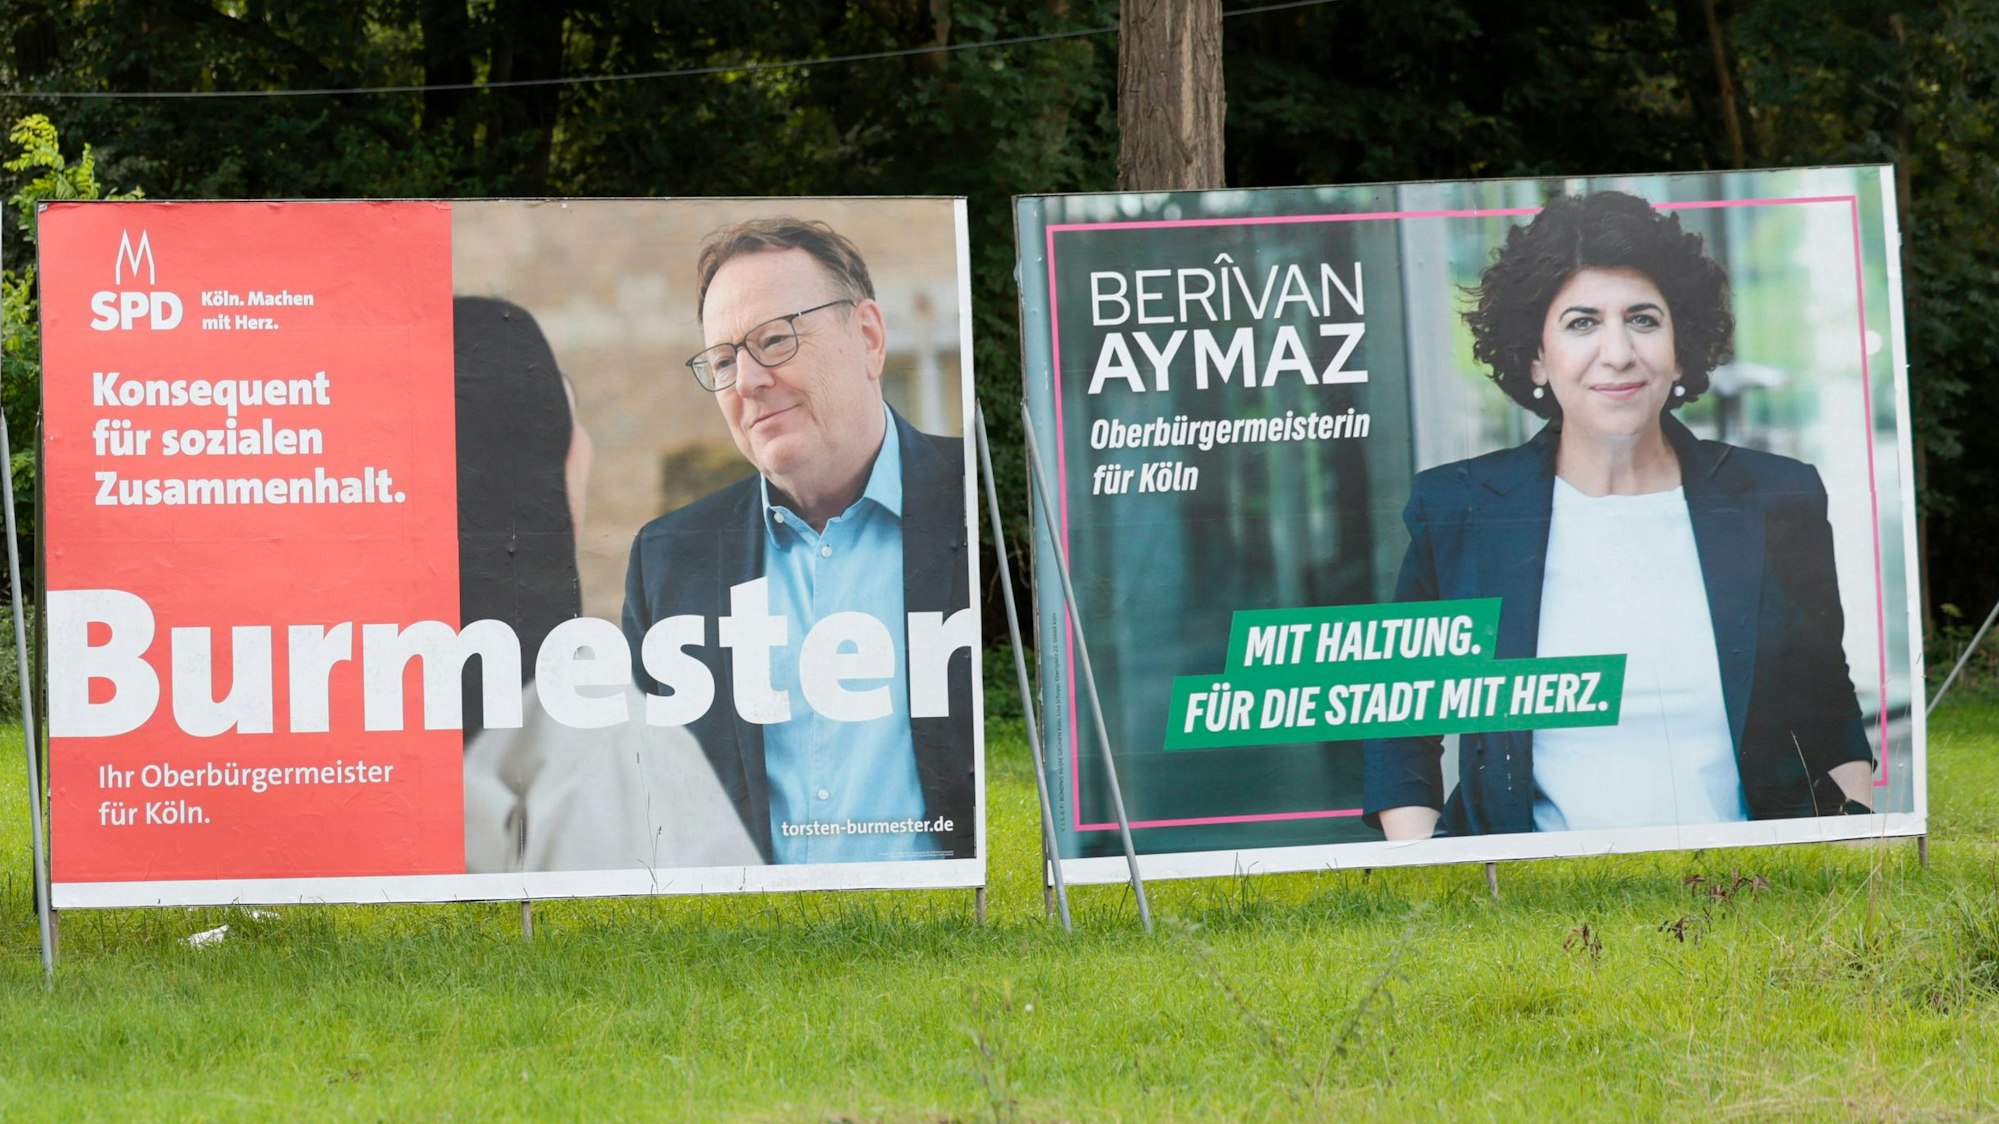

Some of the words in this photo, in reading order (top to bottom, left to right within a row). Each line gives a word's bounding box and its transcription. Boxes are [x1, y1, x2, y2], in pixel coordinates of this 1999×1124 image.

[201, 291, 245, 306] Köln.
[248, 290, 314, 306] Machen
[1090, 253, 1365, 326] BERÎVAN
[90, 291, 184, 331] SPD
[202, 315, 231, 330] mit
[235, 314, 279, 330] Herz.
[1087, 322, 1369, 395] AYMAZ
[92, 371, 331, 417] Konsequent
[92, 419, 151, 456] für
[162, 418, 323, 455] sozialen
[1089, 408, 1371, 451] Oberbürgermeisterin
[94, 466, 406, 506] Zusammenhalt.
[1092, 464, 1134, 496] für
[1138, 461, 1199, 493] Köln
[46, 576, 972, 739] Burmester
[1243, 624, 1312, 667] MIT
[1315, 614, 1482, 663] HALTUNG.
[1183, 682, 1254, 733] FÜR
[1260, 686, 1321, 729] DIE
[1325, 680, 1435, 725] STADT
[1439, 677, 1506, 718] MIT
[1510, 672, 1610, 715] HERZ.
[99, 764, 135, 788] Ihr
[141, 760, 394, 792] Oberbürgermeister
[98, 802, 138, 825] für
[145, 800, 211, 825] Köln.
[781, 815, 954, 836] torsten-burmester.de
